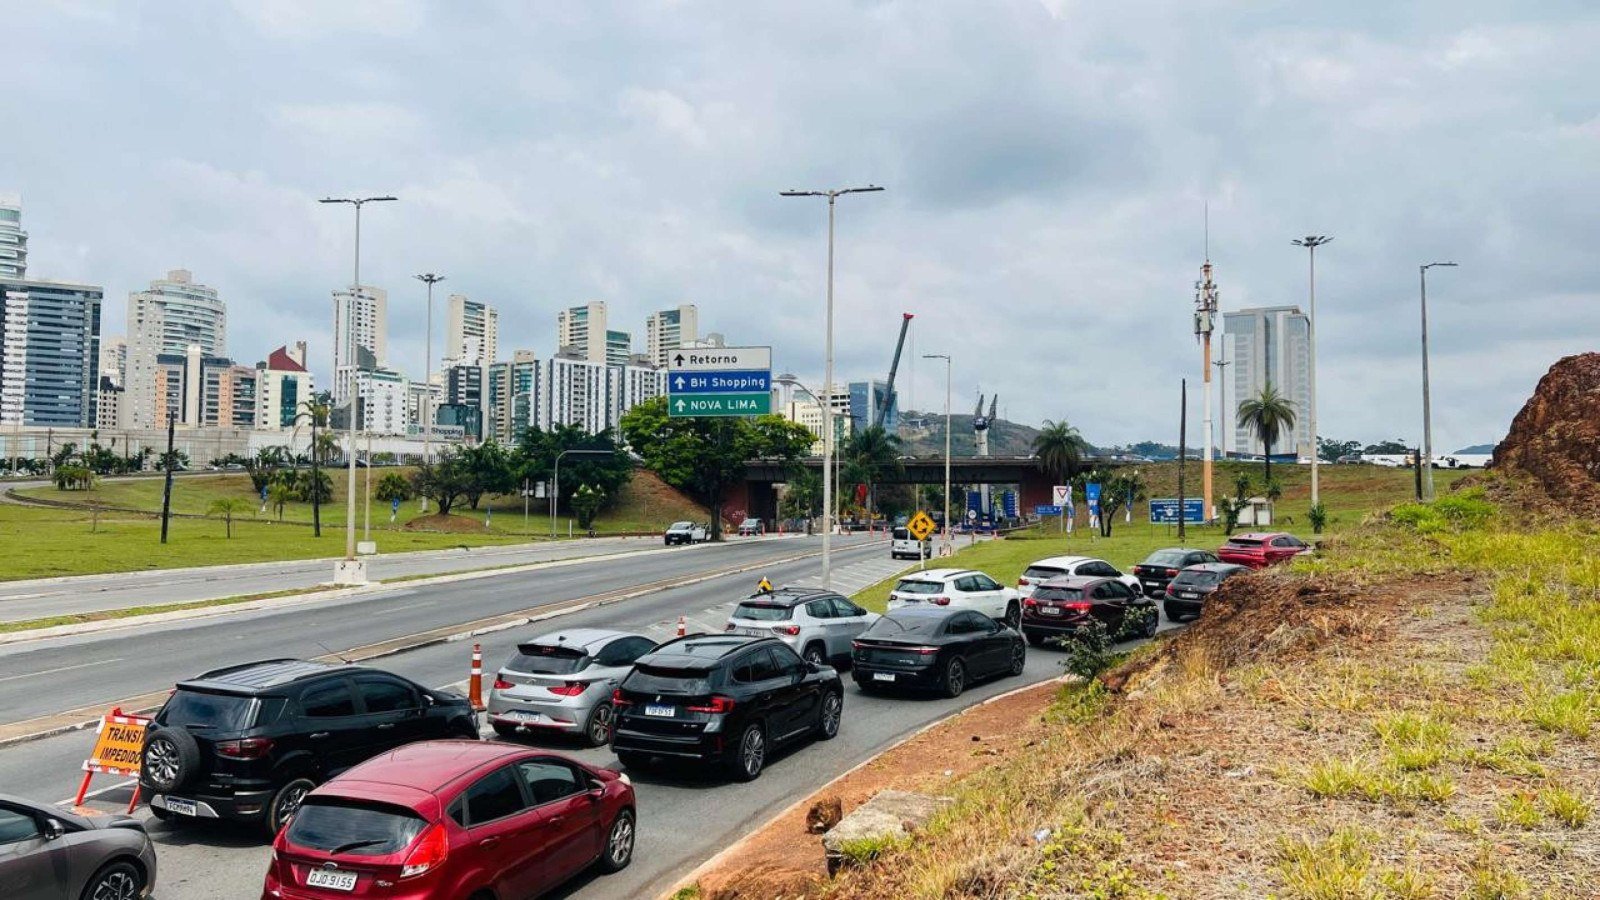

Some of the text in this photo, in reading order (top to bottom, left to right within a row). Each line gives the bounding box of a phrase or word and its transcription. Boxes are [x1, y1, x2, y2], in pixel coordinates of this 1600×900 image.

[689, 354, 738, 365] Retorno
[690, 376, 765, 389] BH Shopping
[690, 399, 758, 410] NOVA LIMA
[107, 726, 143, 744] TRÂNSI
